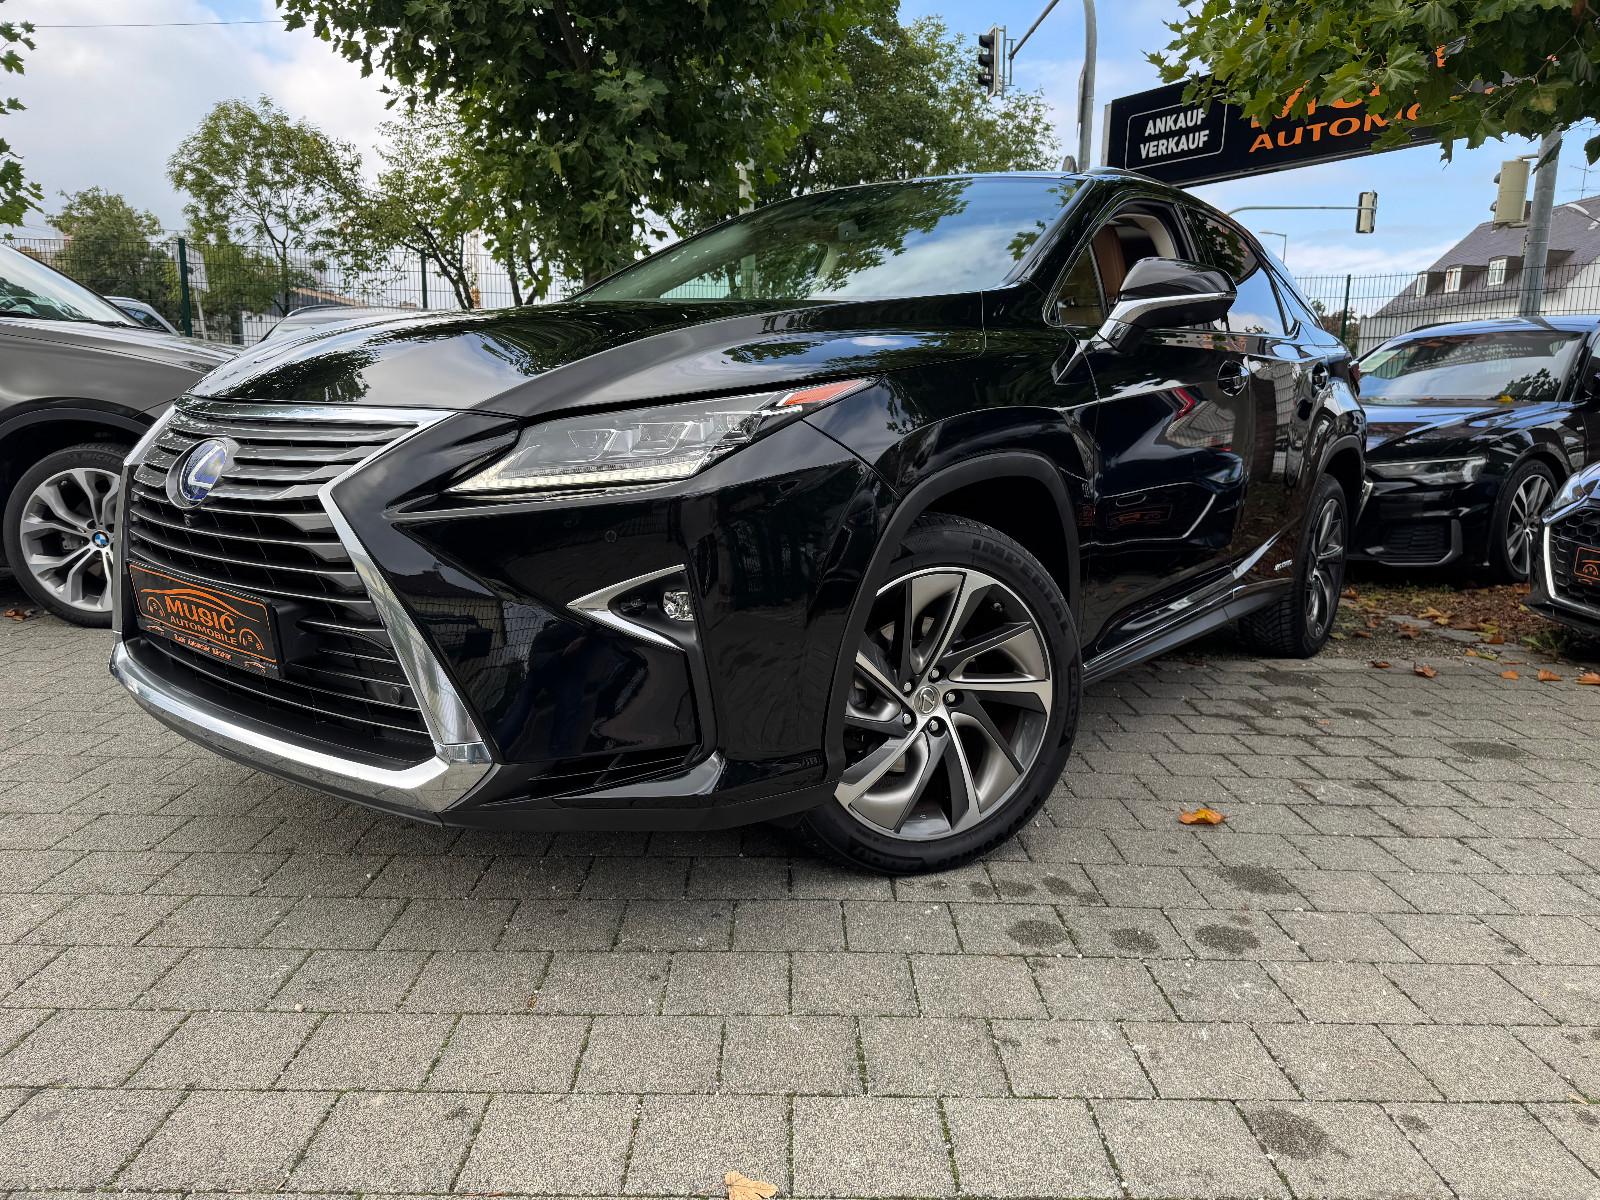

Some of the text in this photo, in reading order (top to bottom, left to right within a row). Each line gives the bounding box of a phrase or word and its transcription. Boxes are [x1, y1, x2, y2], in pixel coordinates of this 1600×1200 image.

[1144, 108, 1206, 137] ANKAUF
[1139, 130, 1210, 159] VERKAUF
[165, 596, 236, 634] MUSIC
[170, 615, 238, 646] AUTOMOBILE
